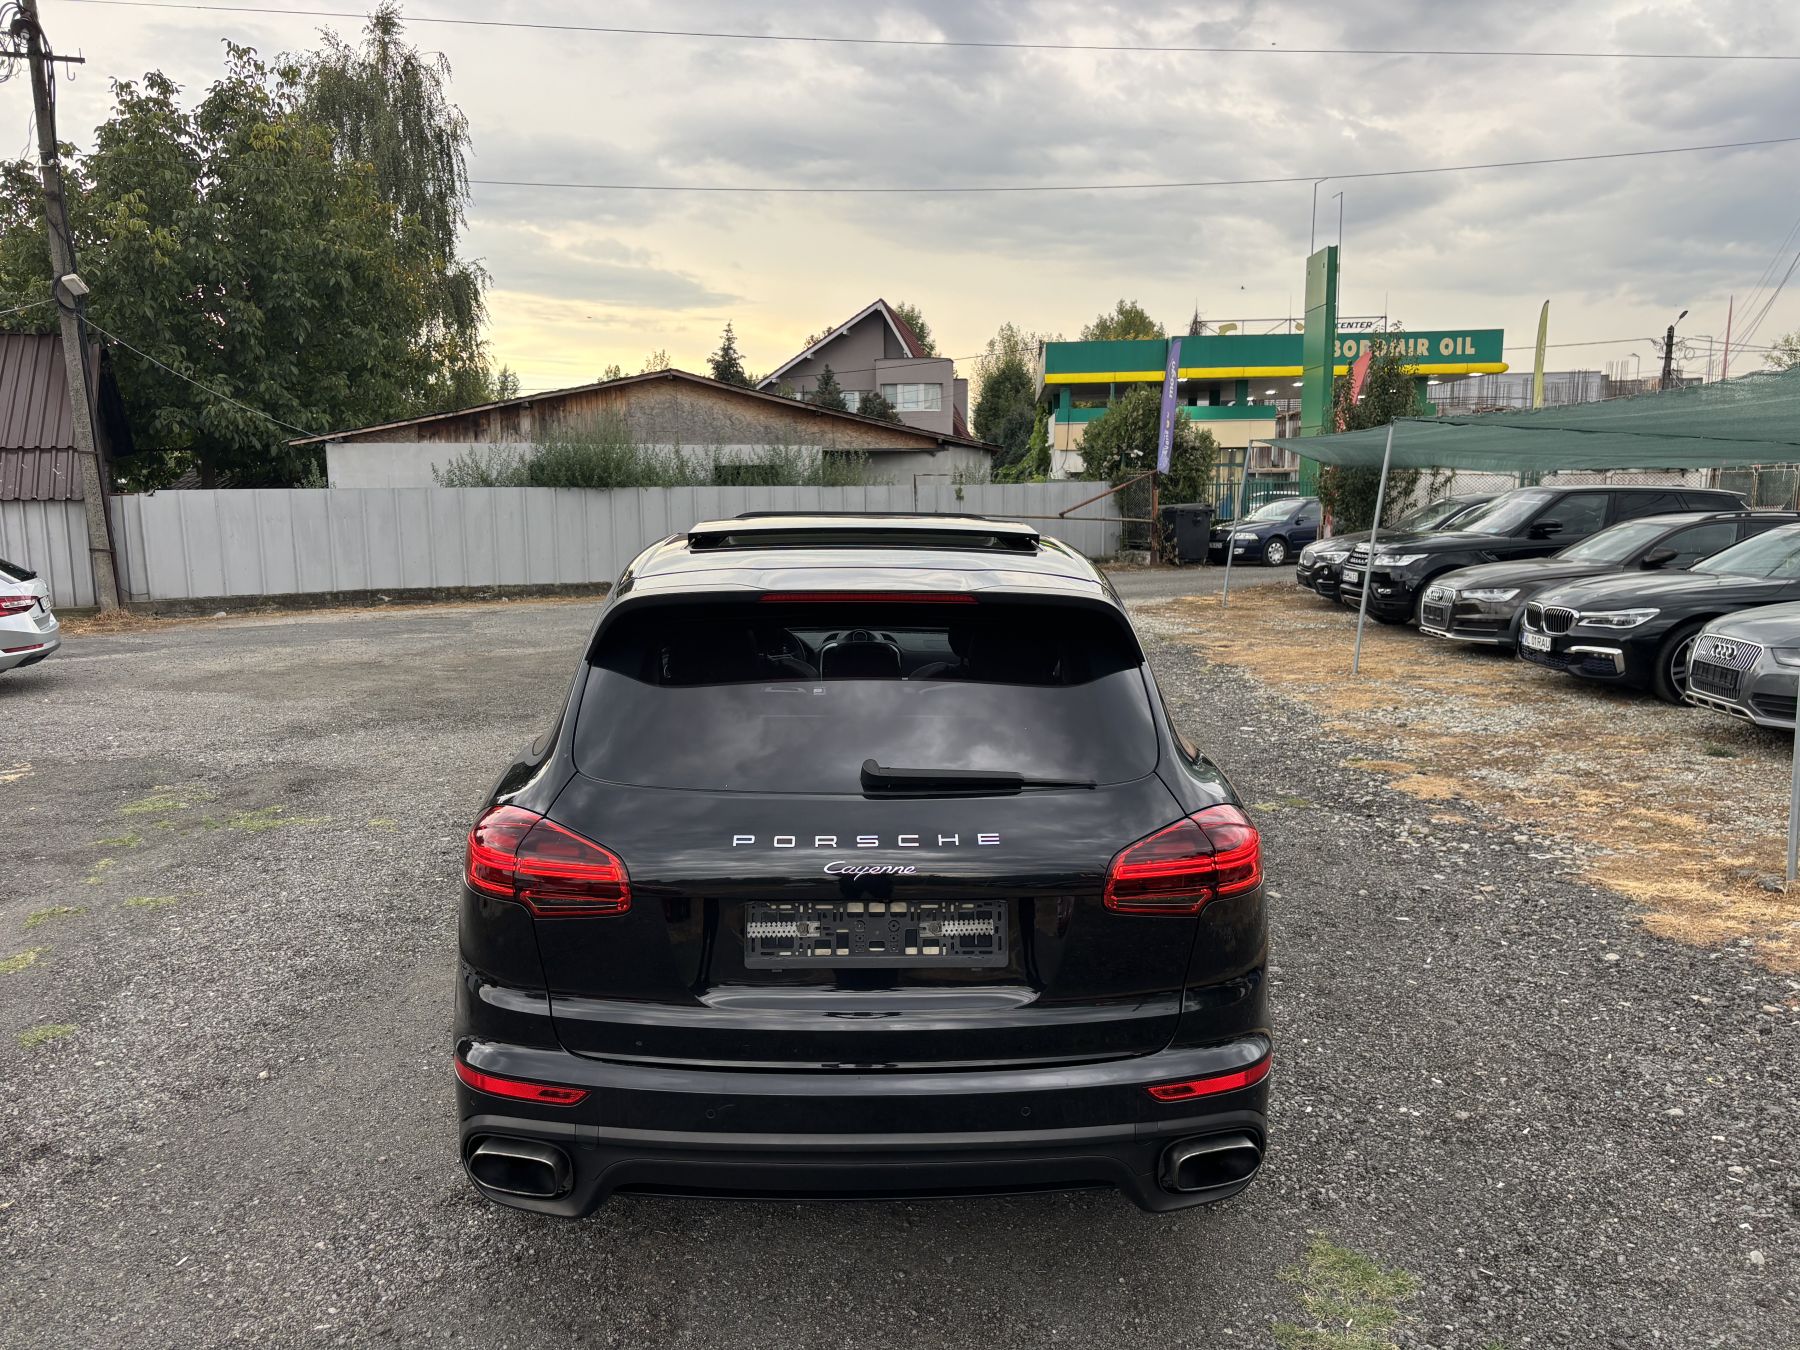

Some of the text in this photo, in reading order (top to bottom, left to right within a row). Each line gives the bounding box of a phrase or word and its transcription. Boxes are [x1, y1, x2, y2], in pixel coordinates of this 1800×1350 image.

[1335, 321, 1373, 329] CENTER
[1439, 337, 1475, 356] OIL
[732, 832, 1001, 848] PORSCHE
[823, 860, 917, 881] Cayenne
